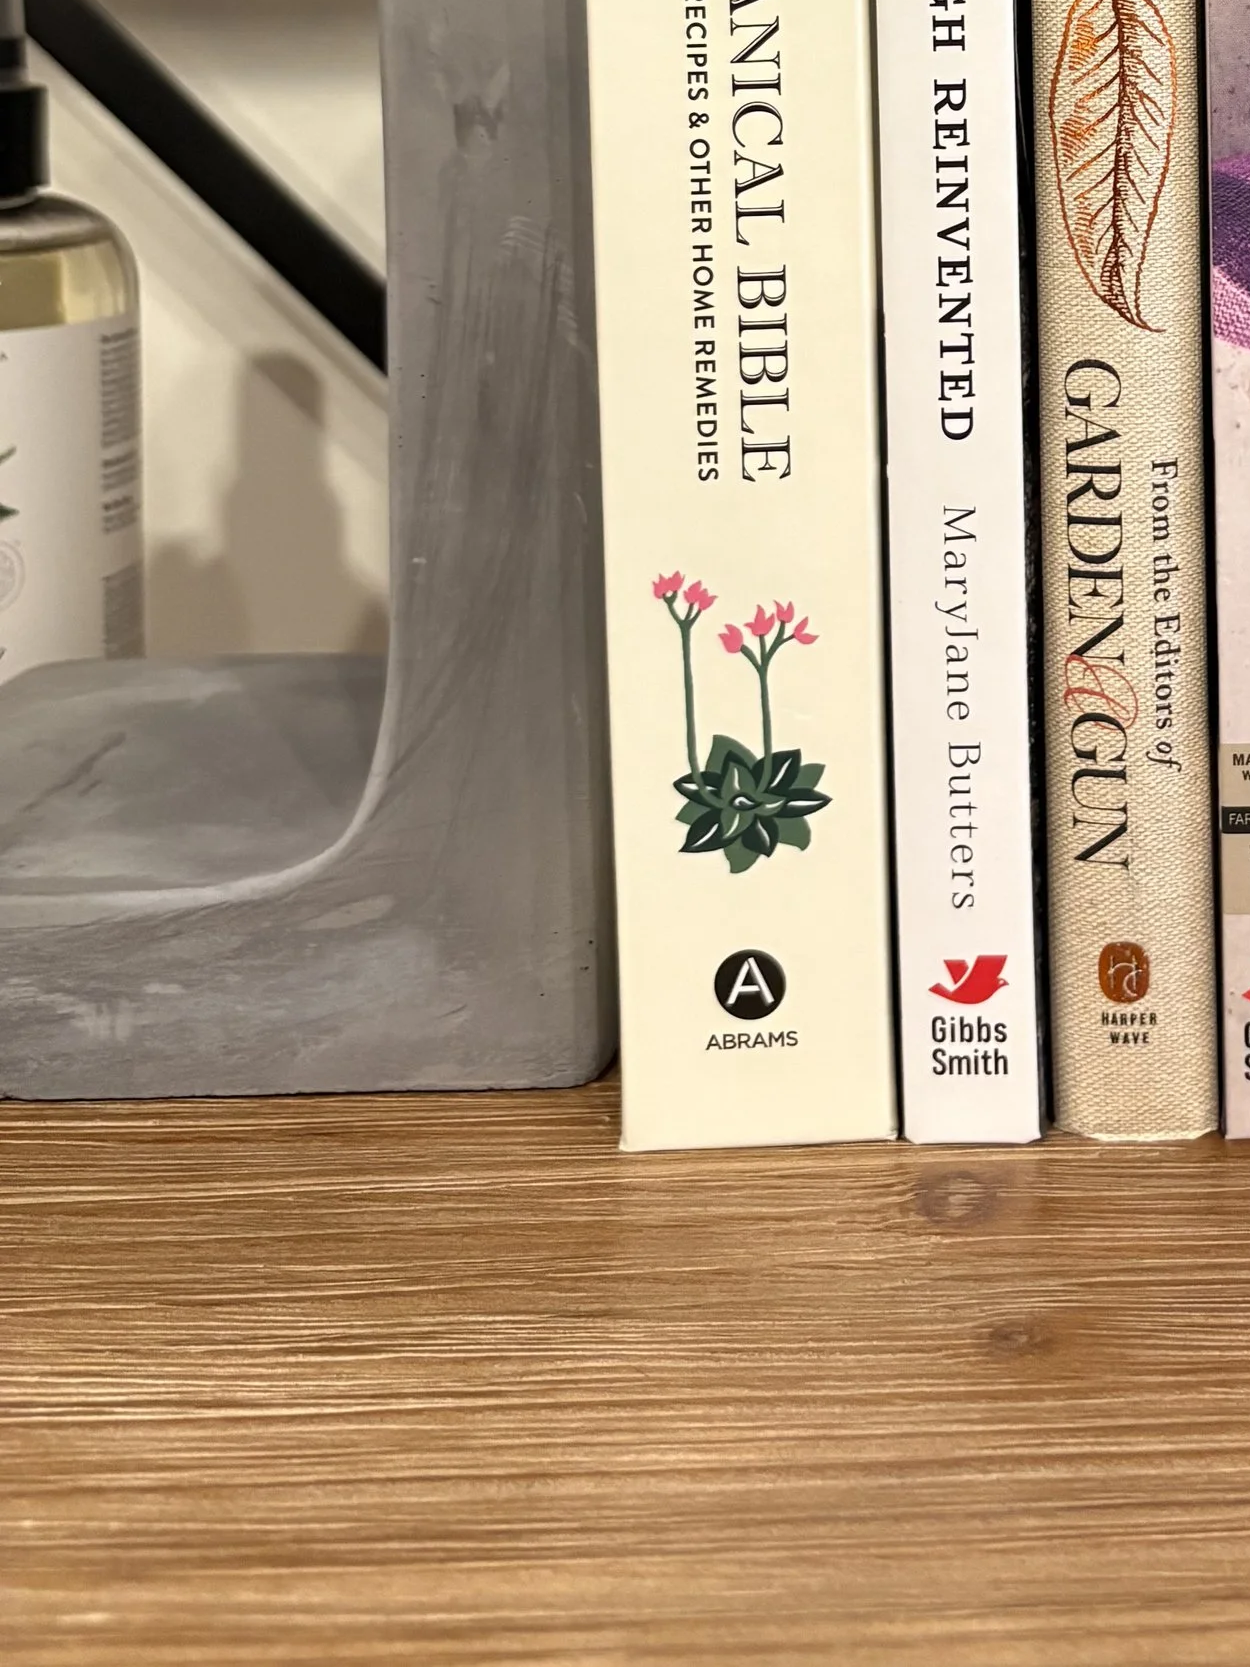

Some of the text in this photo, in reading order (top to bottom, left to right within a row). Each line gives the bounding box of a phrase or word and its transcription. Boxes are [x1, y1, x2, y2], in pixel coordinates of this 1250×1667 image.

[688, 111, 709, 130] &
[688, 139, 712, 233] OTHER
[692, 245, 715, 328] HOME
[932, 79, 976, 440] REINVENTED
[694, 339, 719, 482] REMEDIES
[736, 265, 792, 482] BIBLE
[1146, 458, 1182, 773] From the Editors of
[935, 504, 982, 911] MaryJane Butters
[706, 1031, 799, 1051] ABRAMS
[931, 1016, 1009, 1043] Gibbs
[1101, 1012, 1157, 1026] HARPER
[1110, 1032, 1150, 1044] WAVE
[931, 1048, 1009, 1076] Smith
